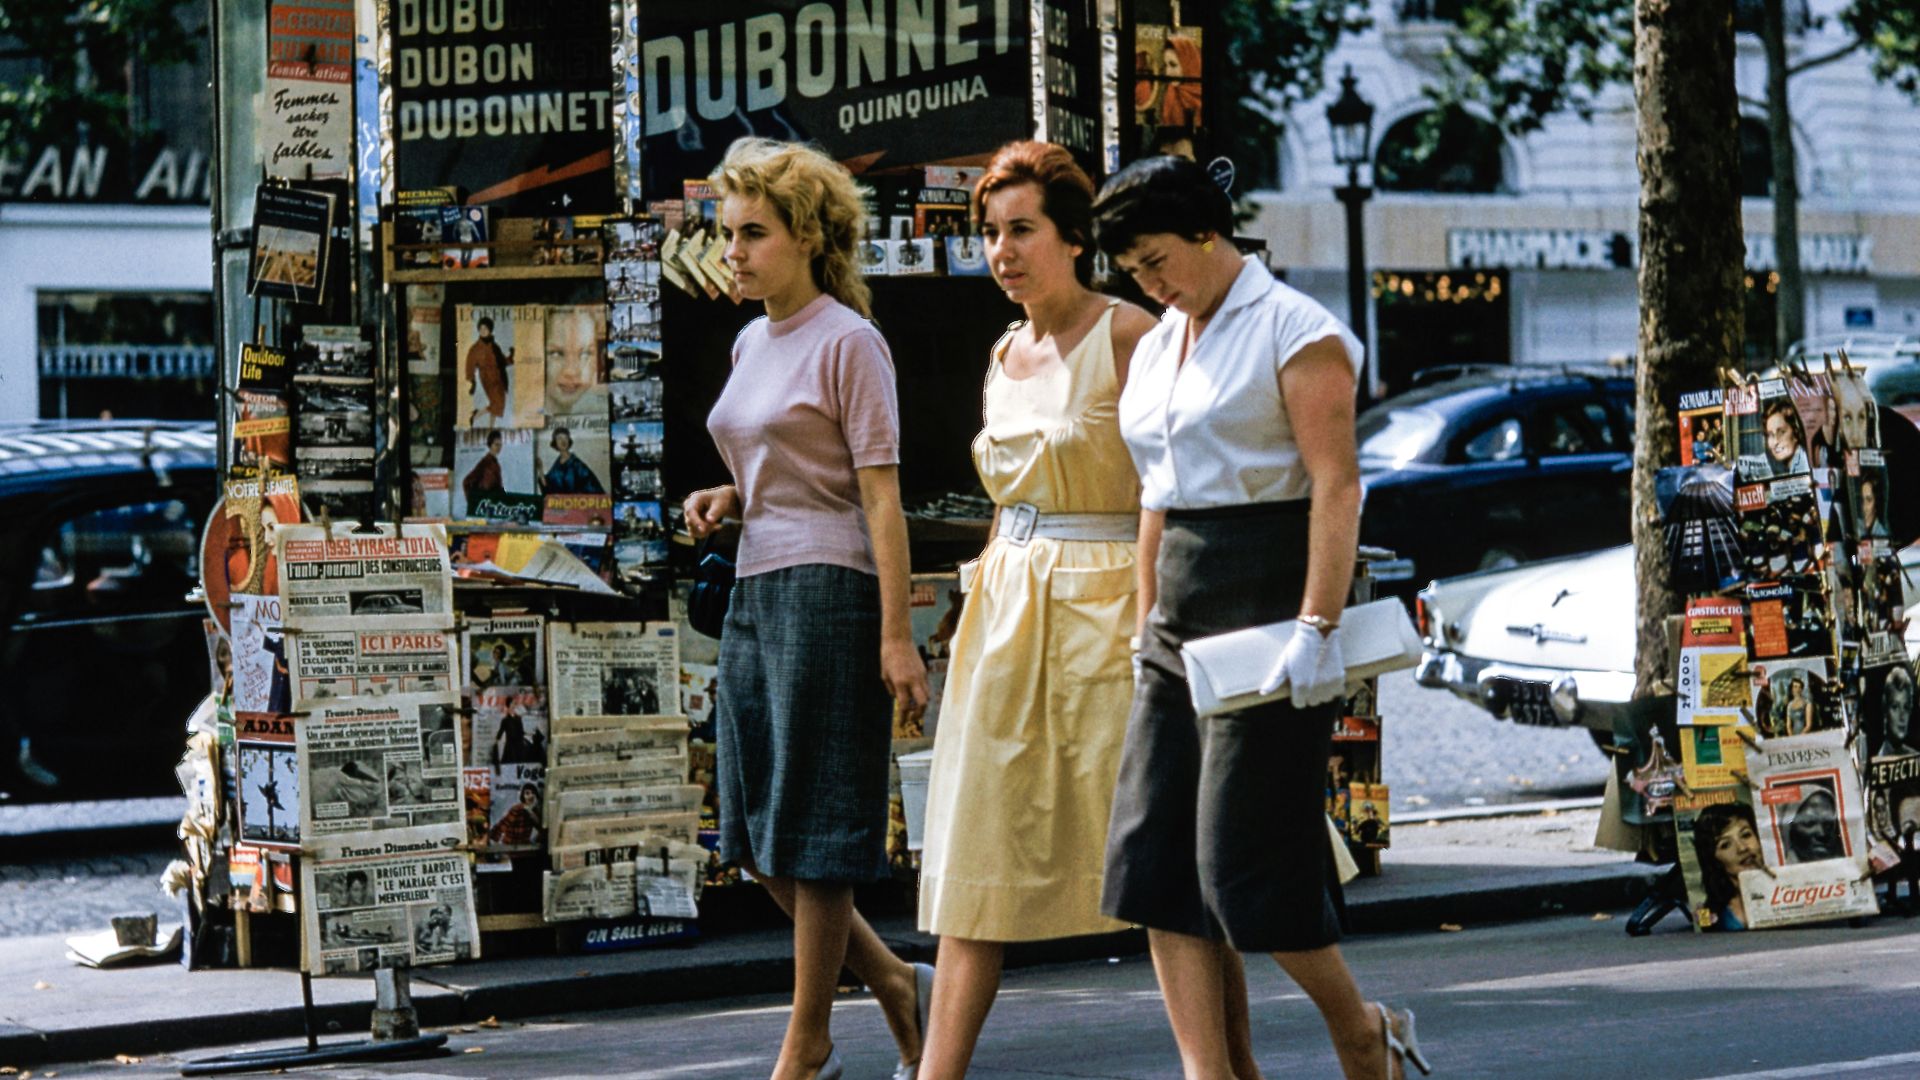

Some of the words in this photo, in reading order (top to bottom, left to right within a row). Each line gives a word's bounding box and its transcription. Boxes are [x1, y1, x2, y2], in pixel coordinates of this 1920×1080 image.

[400, 0, 504, 36] DUBO
[269, 63, 349, 80] Consteation
[400, 43, 534, 88] DUBON
[643, 0, 1011, 136] DUBONNET
[274, 87, 340, 114] Femmes
[839, 75, 989, 134] QUINQUINA
[286, 108, 330, 124] sachez
[401, 91, 610, 141] DUBONNET
[273, 140, 334, 164] faibles
[243, 347, 286, 367] Outdoor
[242, 365, 262, 381] Life
[227, 481, 259, 499] VOTRE
[356, 538, 400, 555] VIRAGE
[405, 537, 440, 553] TOTAL
[381, 558, 442, 574] CONSTRUCTEURS
[322, 594, 347, 604] CALCUL
[312, 640, 354, 648] QUESTIONS
[361, 636, 385, 650] ICI
[393, 634, 443, 649] PARIS
[325, 709, 355, 718] France
[356, 706, 399, 716] Dimanche
[307, 731, 318, 739] Un
[320, 730, 344, 740] grand
[346, 728, 386, 739] chirurgien
[1767, 747, 1831, 767] L'EXPRESS
[517, 765, 545, 780] Vogu
[647, 794, 673, 803] TIMES
[341, 847, 382, 858] France
[384, 840, 438, 853] Dimanche
[377, 866, 416, 879] BRIGITTE
[423, 863, 457, 874] BARDOT
[399, 876, 437, 889] MARIAGE
[441, 874, 465, 884] C'EST
[1771, 883, 1846, 906] L'argus
[586, 928, 608, 944] ON
[610, 925, 644, 941] SALE
[648, 922, 684, 937] HERE
